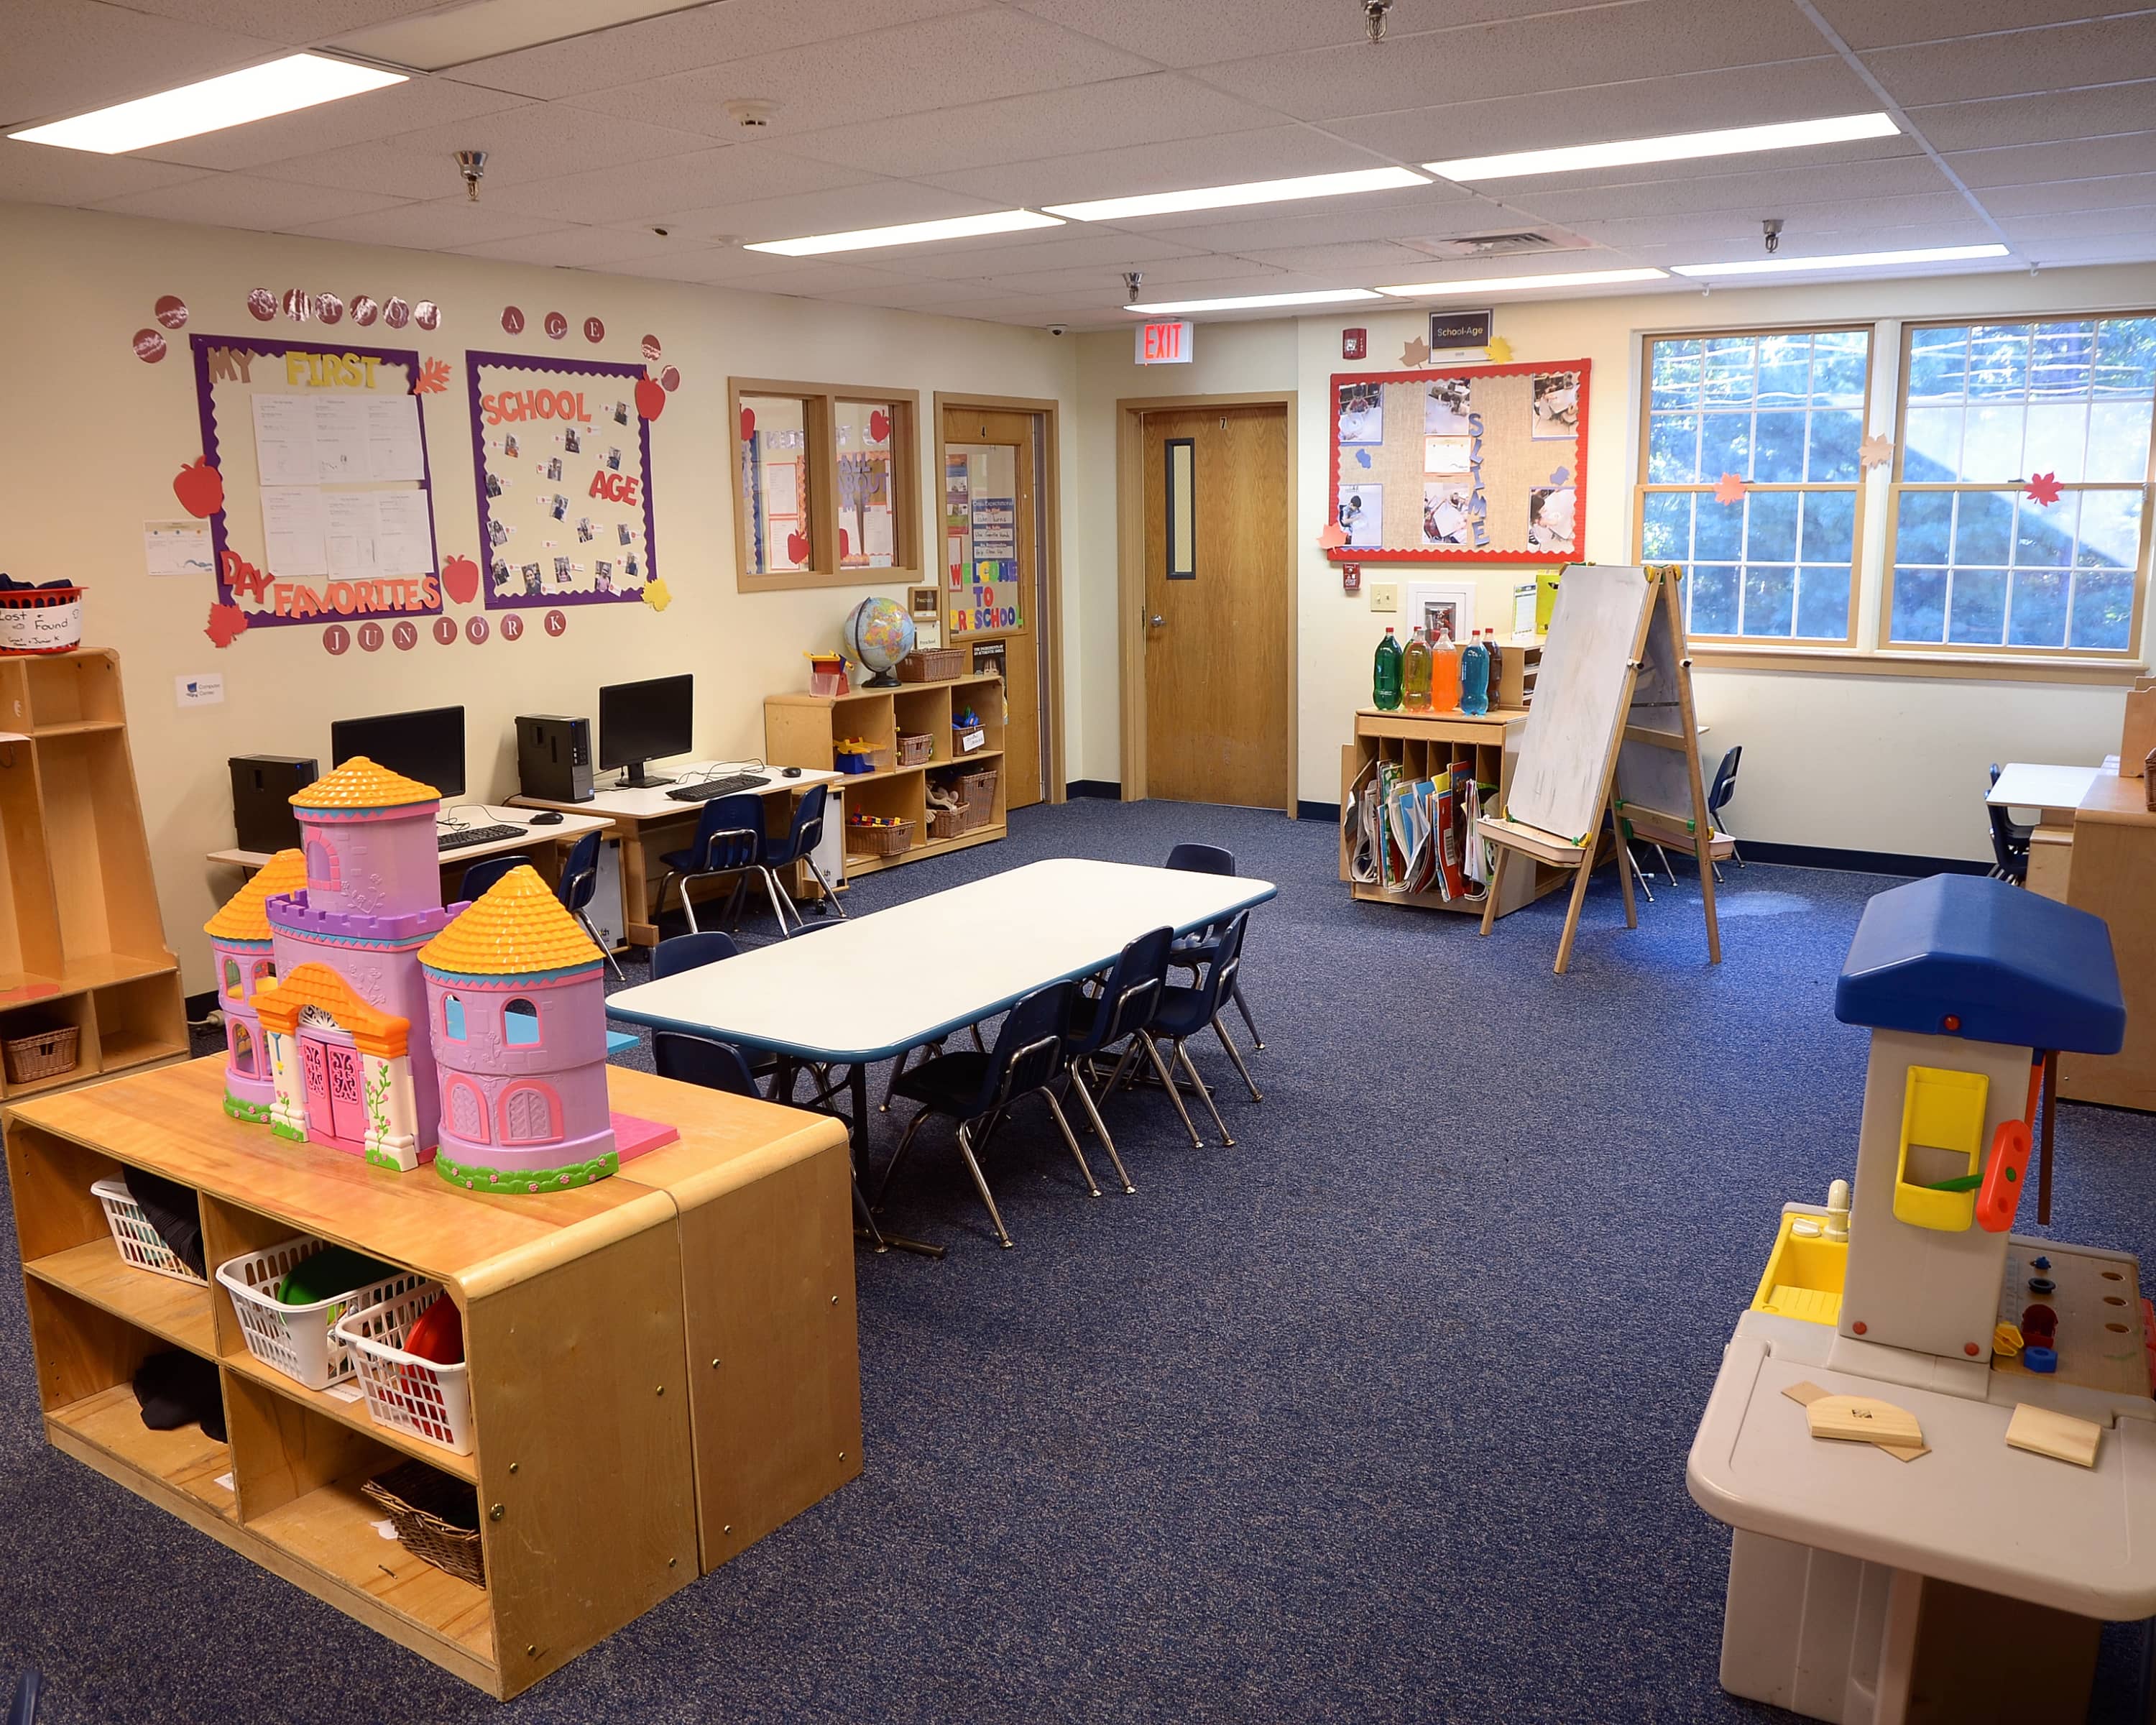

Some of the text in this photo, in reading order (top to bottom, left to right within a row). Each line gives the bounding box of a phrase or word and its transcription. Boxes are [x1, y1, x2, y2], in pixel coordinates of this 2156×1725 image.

[506, 311, 602, 339] AGE
[1437, 326, 1483, 337] School-Age
[1144, 323, 1183, 359] EXIT
[208, 346, 382, 388] MY FIRST
[482, 388, 592, 426] SCHOOL
[1220, 418, 1226, 429] 7
[839, 451, 871, 473] ALL
[589, 470, 640, 506] AGE
[1467, 413, 1490, 548] SLIME
[220, 550, 442, 620] DAY FAVORITES
[950, 560, 1018, 586] WELCOME
[972, 586, 994, 607] TO
[0, 610, 27, 622] Lost
[34, 617, 68, 630] Found
[950, 604, 1024, 631] PRESCHOOL
[330, 620, 520, 651] JUNIOR
